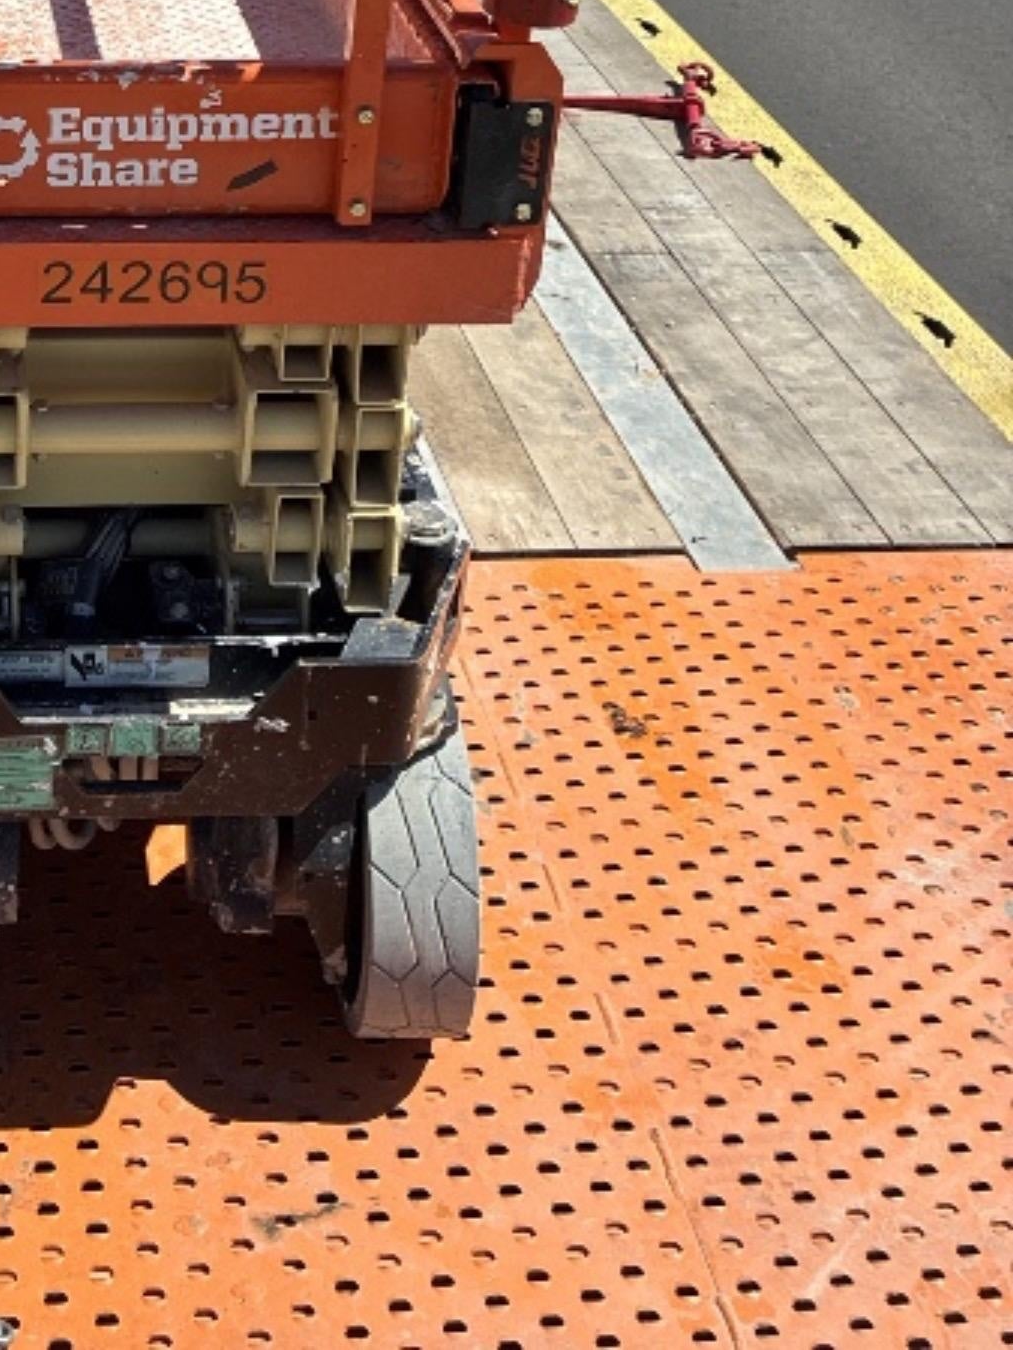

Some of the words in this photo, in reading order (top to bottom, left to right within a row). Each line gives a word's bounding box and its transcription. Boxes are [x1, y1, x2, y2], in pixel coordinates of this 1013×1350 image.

[46, 107, 340, 150] Equipment
[46, 152, 199, 187] Share
[40, 260, 267, 304] 242695
